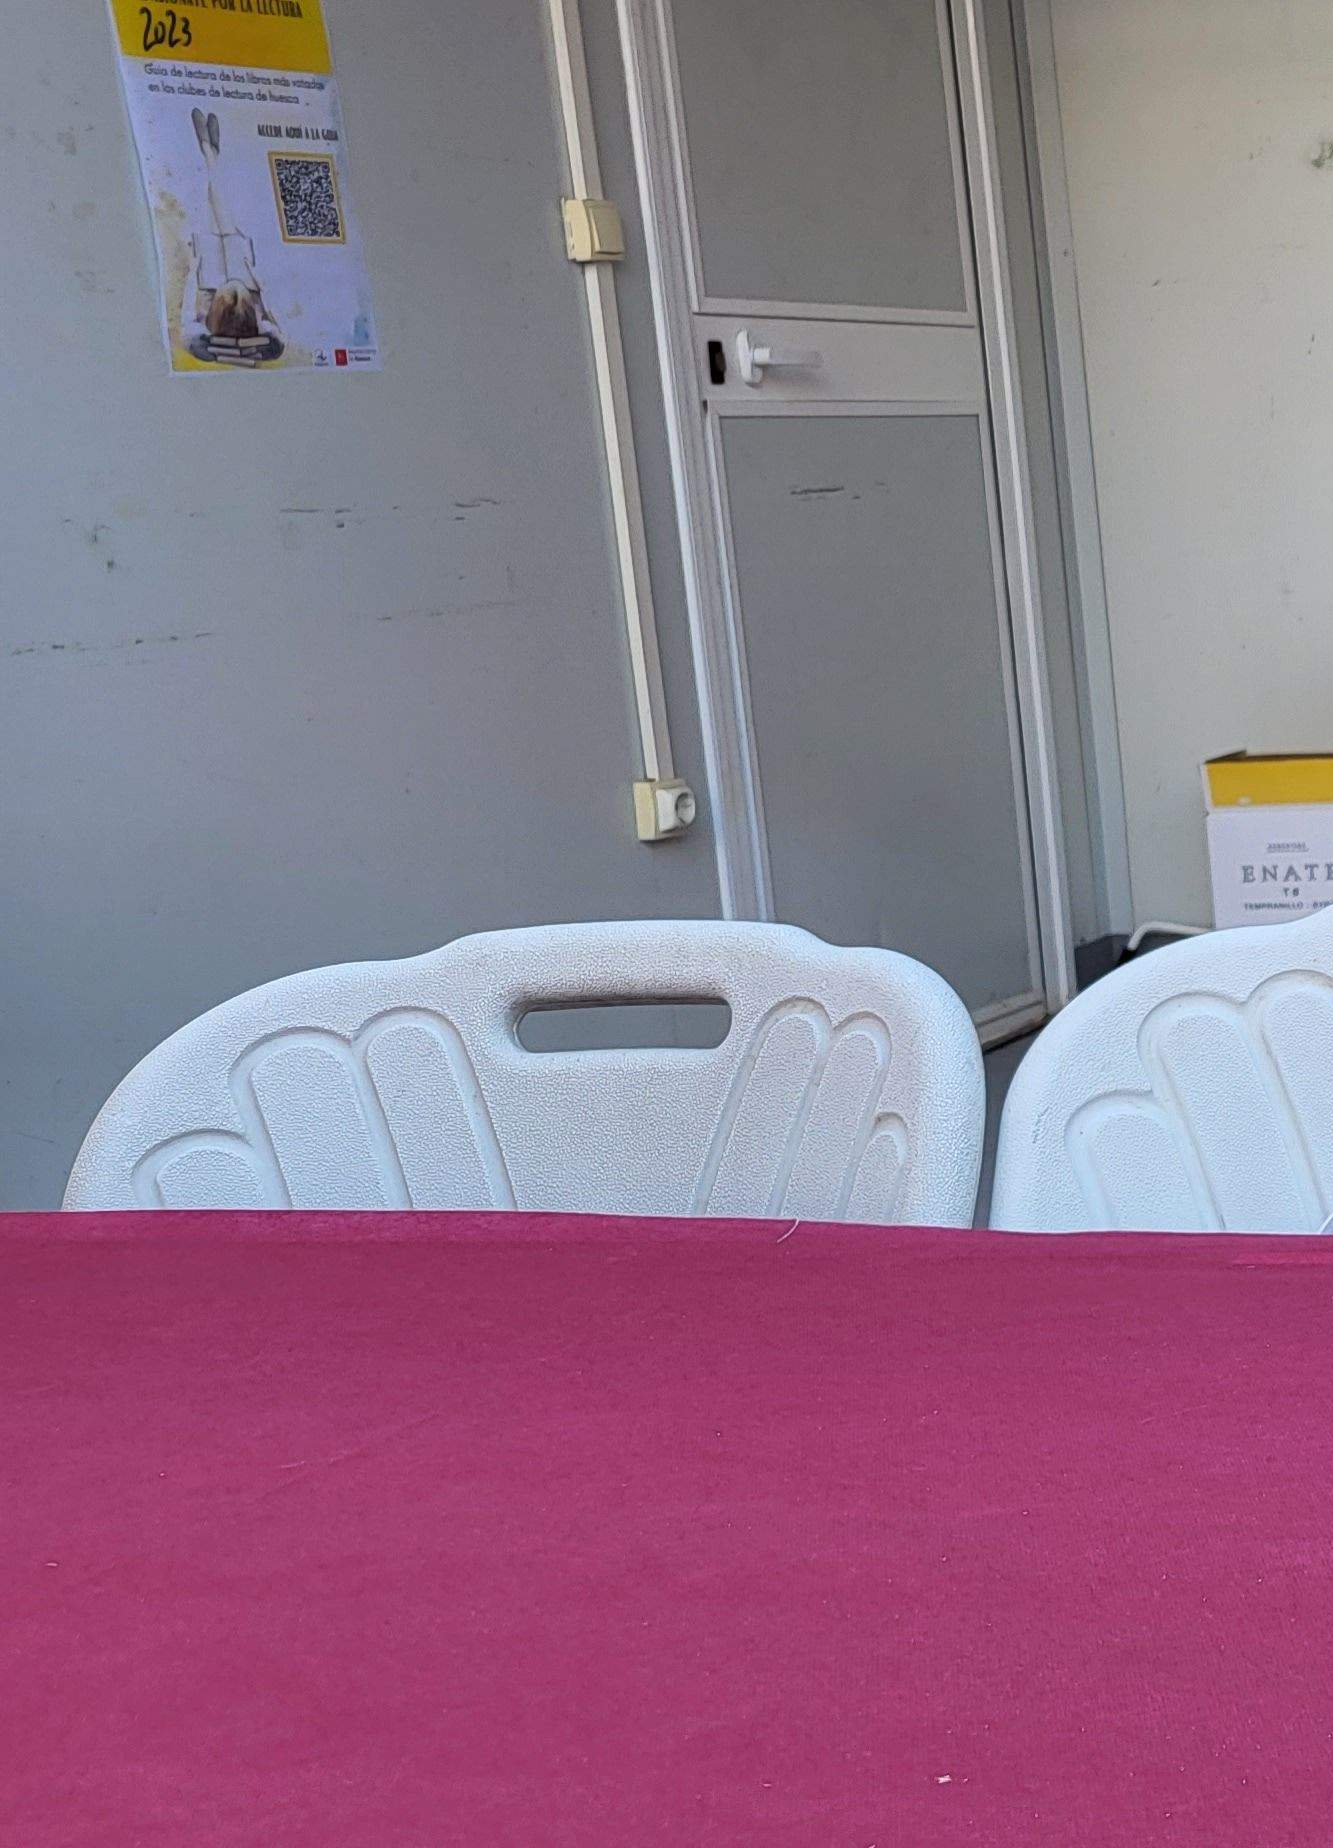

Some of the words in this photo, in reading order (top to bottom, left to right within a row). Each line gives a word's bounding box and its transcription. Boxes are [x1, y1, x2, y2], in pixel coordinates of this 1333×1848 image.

[140, 6, 192, 52] 2023
[161, 81, 175, 94] los
[178, 82, 206, 96] clubes
[208, 85, 220, 97] de
[222, 86, 254, 100] lectura
[256, 89, 267, 101] de
[171, 64, 182, 77] de
[184, 66, 217, 80] lectura
[220, 69, 231, 81] de
[232, 69, 245, 83] los
[246, 72, 271, 85] libros
[292, 78, 324, 91] votados
